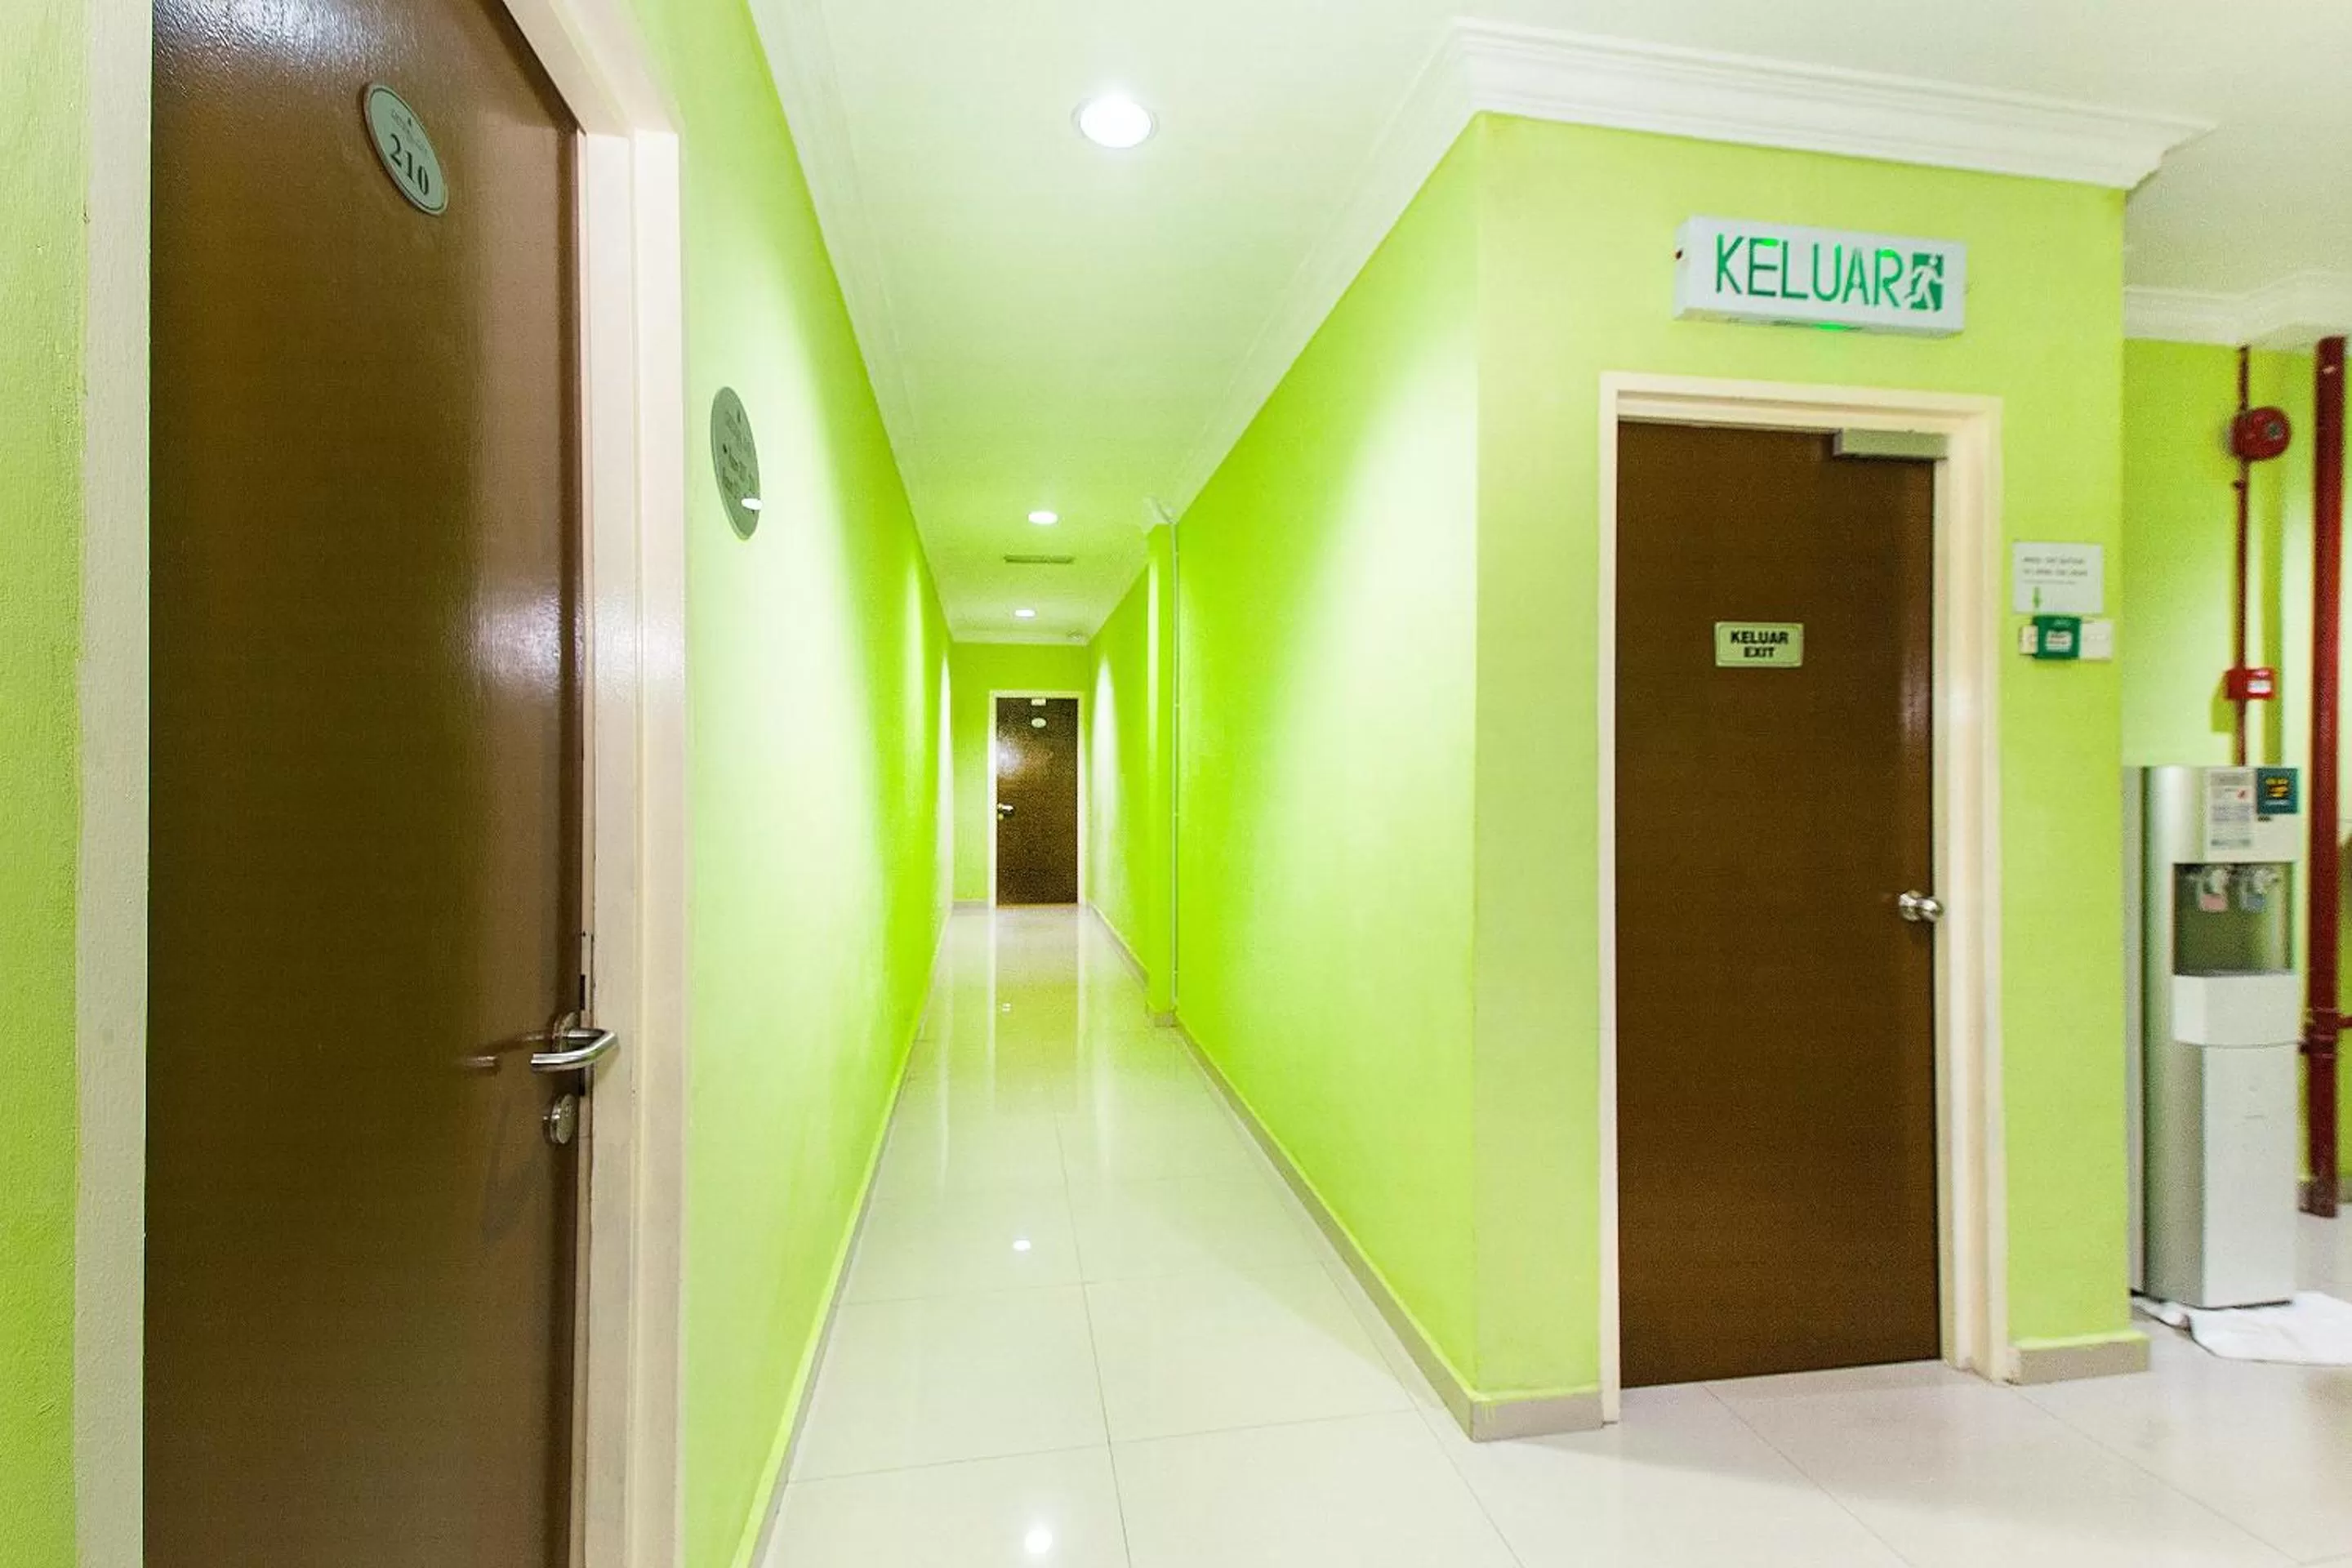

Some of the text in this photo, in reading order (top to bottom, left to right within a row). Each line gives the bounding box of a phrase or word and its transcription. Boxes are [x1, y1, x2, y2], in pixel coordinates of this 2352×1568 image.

[389, 132, 430, 195] 210
[1715, 233, 1904, 308] KELUAR
[1730, 630, 1789, 644] KELUAR
[1744, 646, 1774, 658] EXIT
